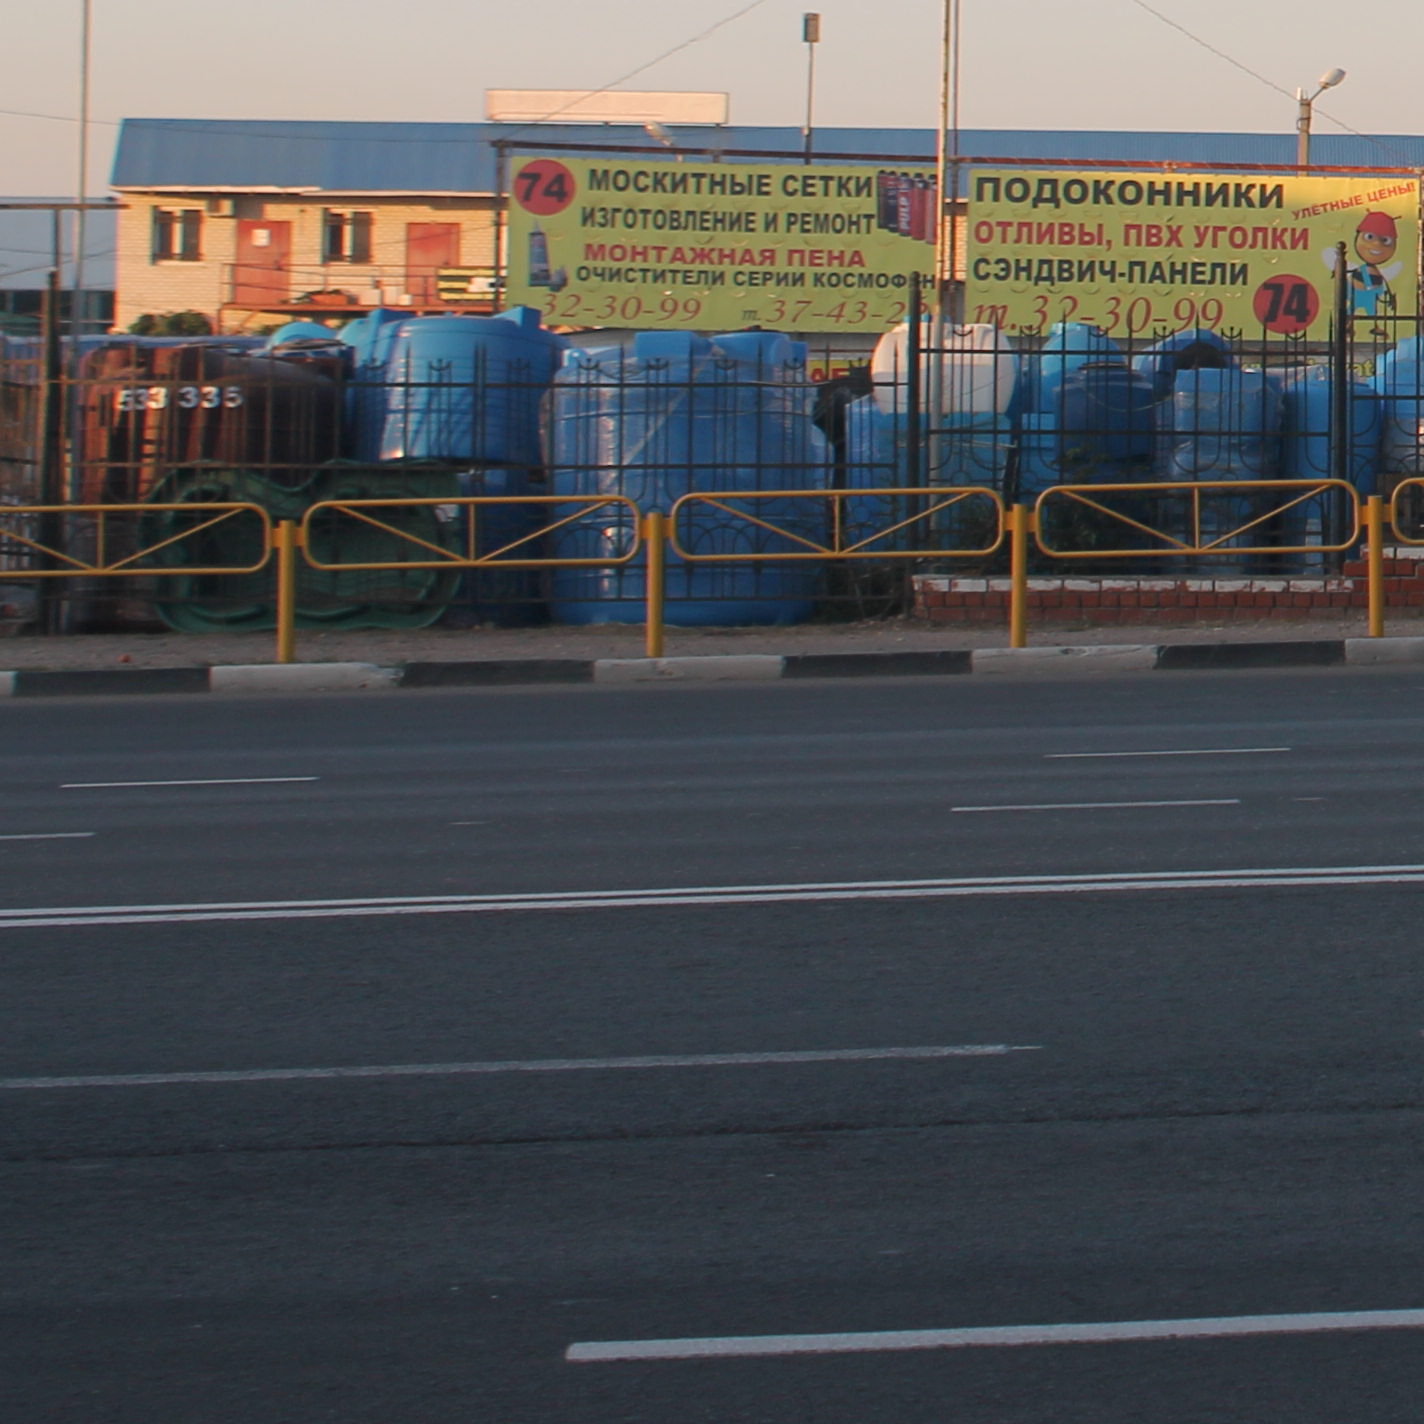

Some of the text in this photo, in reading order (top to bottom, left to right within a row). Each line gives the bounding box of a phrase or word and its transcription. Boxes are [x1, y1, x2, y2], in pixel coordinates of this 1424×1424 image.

[516, 172, 568, 202] 74
[587, 169, 872, 199] МОСКИТНЫЕ СЕТКИ
[975, 176, 1284, 209] ПОДОКОННИКИ
[1292, 182, 1416, 220] УЛЕТНЫЕ ЦЕНЫ!
[581, 207, 875, 235] ИЗГОТОВЛЕНИЕ И РЕМОНТ
[974, 221, 1310, 251] ОТЛИВЫ, ПВХ УГОЛКИ
[584, 244, 866, 267] МОНТАЖНАЯ ПЕНА
[576, 266, 936, 289] ОЧИСТИТЕЛИ СЕРИИ КОСМОФН
[972, 258, 1248, 286] СЭНДВИЧ-ПАНЕЛИ
[1263, 283, 1311, 323] 74
[179, 386, 243, 408] 335
